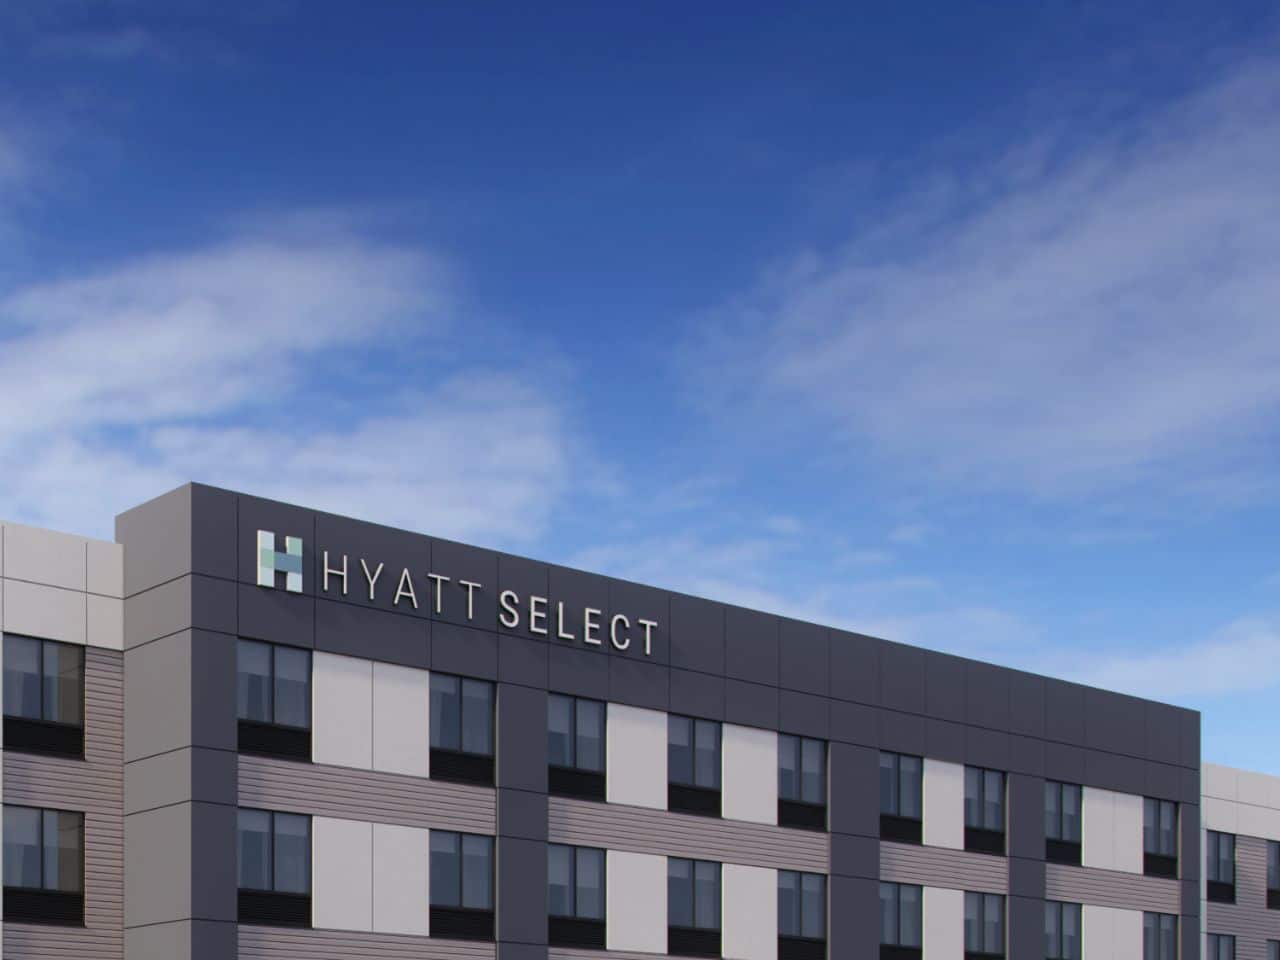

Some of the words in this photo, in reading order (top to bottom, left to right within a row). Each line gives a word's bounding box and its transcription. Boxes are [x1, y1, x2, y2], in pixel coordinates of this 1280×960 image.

[256, 529, 303, 593] H
[323, 550, 482, 620] HYATT
[499, 590, 658, 656] SELECT
